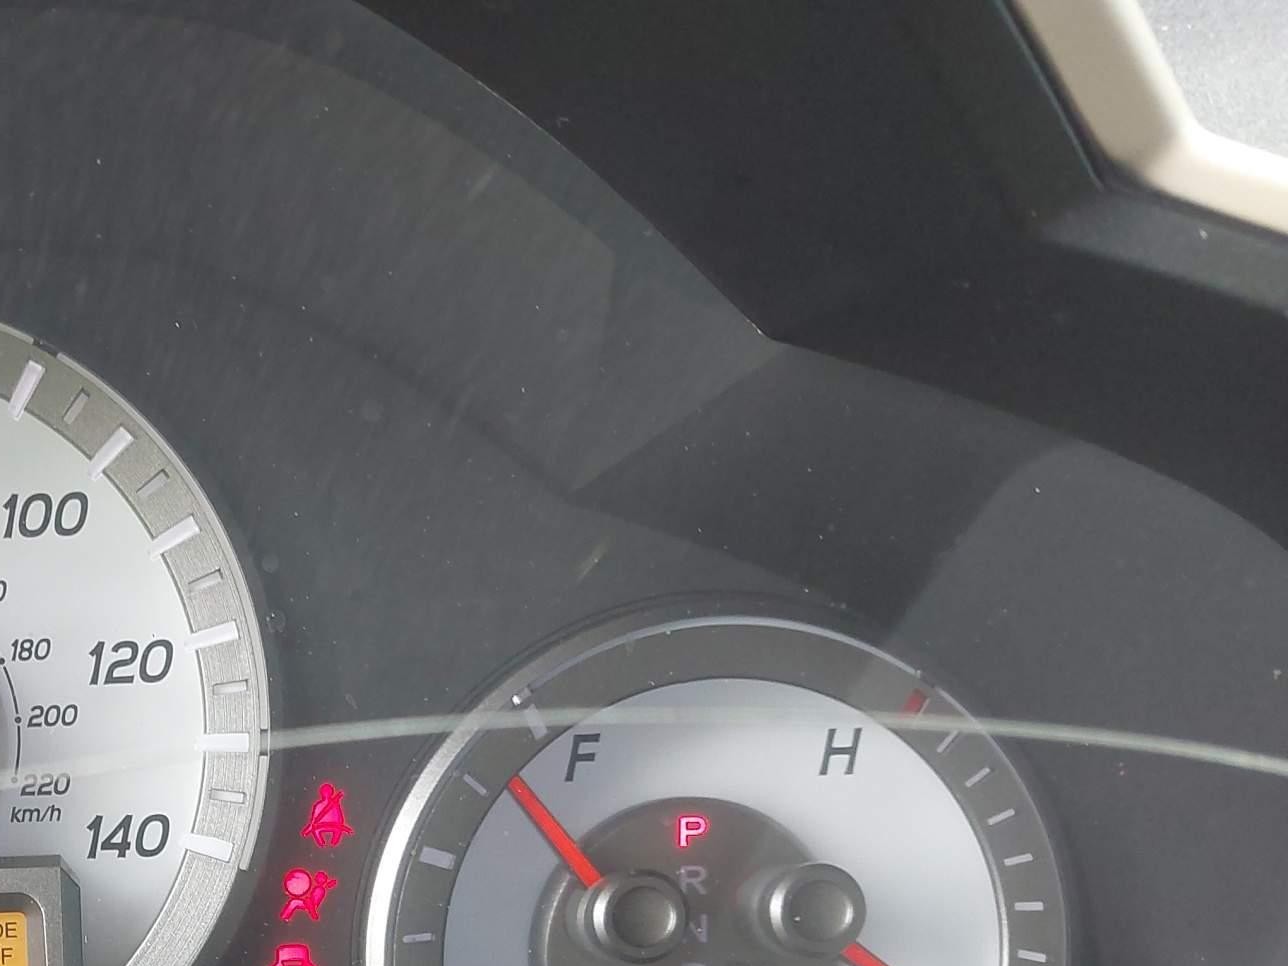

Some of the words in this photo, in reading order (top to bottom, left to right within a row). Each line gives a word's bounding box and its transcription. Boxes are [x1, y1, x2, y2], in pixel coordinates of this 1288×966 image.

[2, 491, 89, 540] 100
[11, 638, 52, 662] 180
[89, 638, 174, 686] 120
[27, 703, 78, 727] 200
[564, 732, 601, 782] F
[818, 728, 862, 776] H
[20, 773, 71, 797] 220
[10, 803, 62, 825] km/h
[86, 813, 170, 859] 140
[678, 815, 707, 847] P
[679, 866, 707, 894] R
